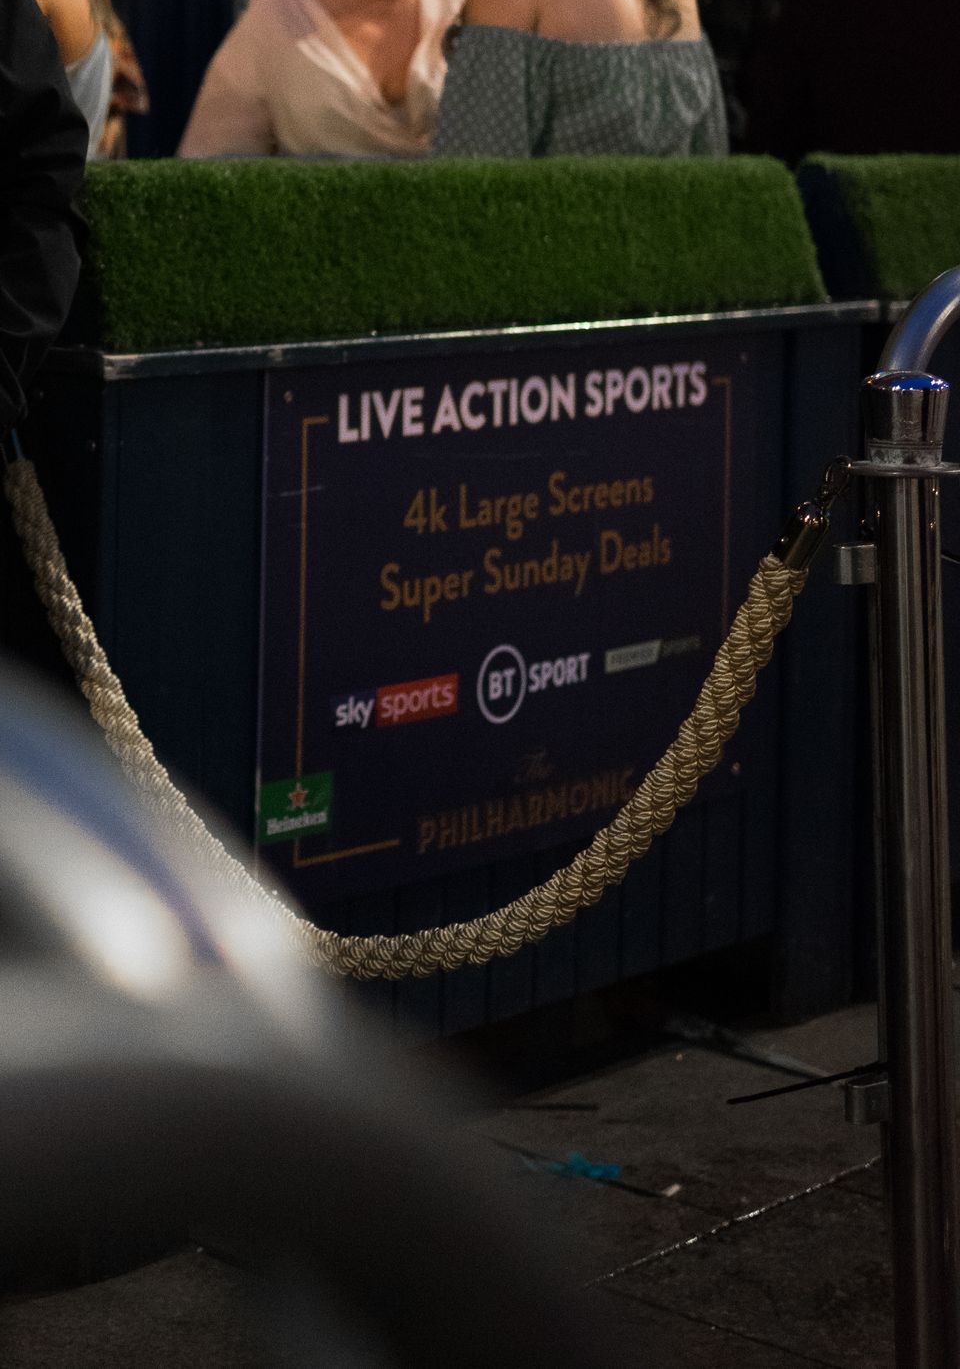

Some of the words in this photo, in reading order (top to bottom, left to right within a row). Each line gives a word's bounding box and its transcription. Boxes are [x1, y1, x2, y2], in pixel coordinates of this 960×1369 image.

[338, 386, 425, 444] LIVE
[432, 373, 576, 434] ACTION
[584, 361, 708, 418] SPORTS
[403, 488, 447, 534] 4k
[459, 484, 538, 540] Large
[548, 470, 654, 517] Screens
[380, 562, 473, 623] Super
[484, 538, 590, 596] Sunday
[600, 524, 672, 573] Deals
[335, 695, 375, 729] sky
[379, 678, 456, 726] sports
[487, 668, 516, 701] BT
[528, 652, 592, 693] SPORT
[266, 810, 329, 836] Heineken
